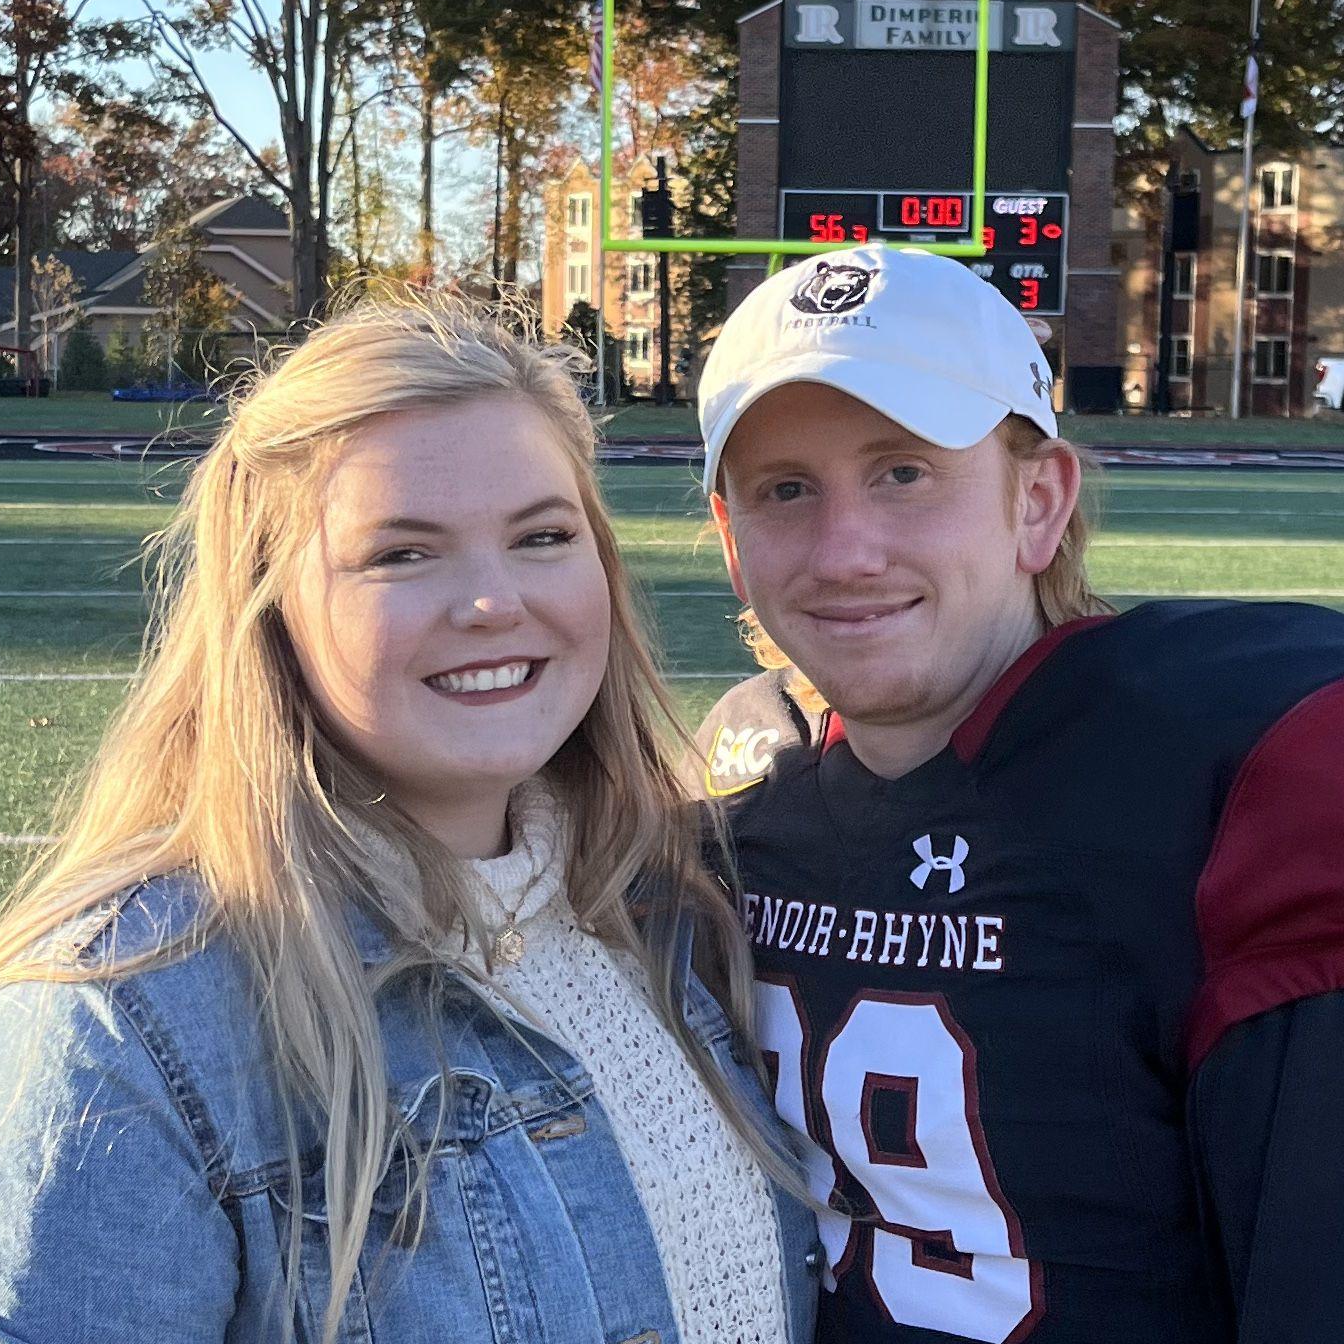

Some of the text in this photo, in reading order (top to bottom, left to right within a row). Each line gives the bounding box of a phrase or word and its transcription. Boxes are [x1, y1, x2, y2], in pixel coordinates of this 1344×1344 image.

[871, 4, 980, 25] DIMPERI
[886, 27, 972, 47] FAMILY
[901, 196, 963, 226] 0:00
[992, 197, 1049, 215] GUEST
[809, 213, 846, 244] 56
[1019, 216, 1038, 246] 3
[1019, 277, 1040, 310] 3
[710, 726, 781, 778] SAC
